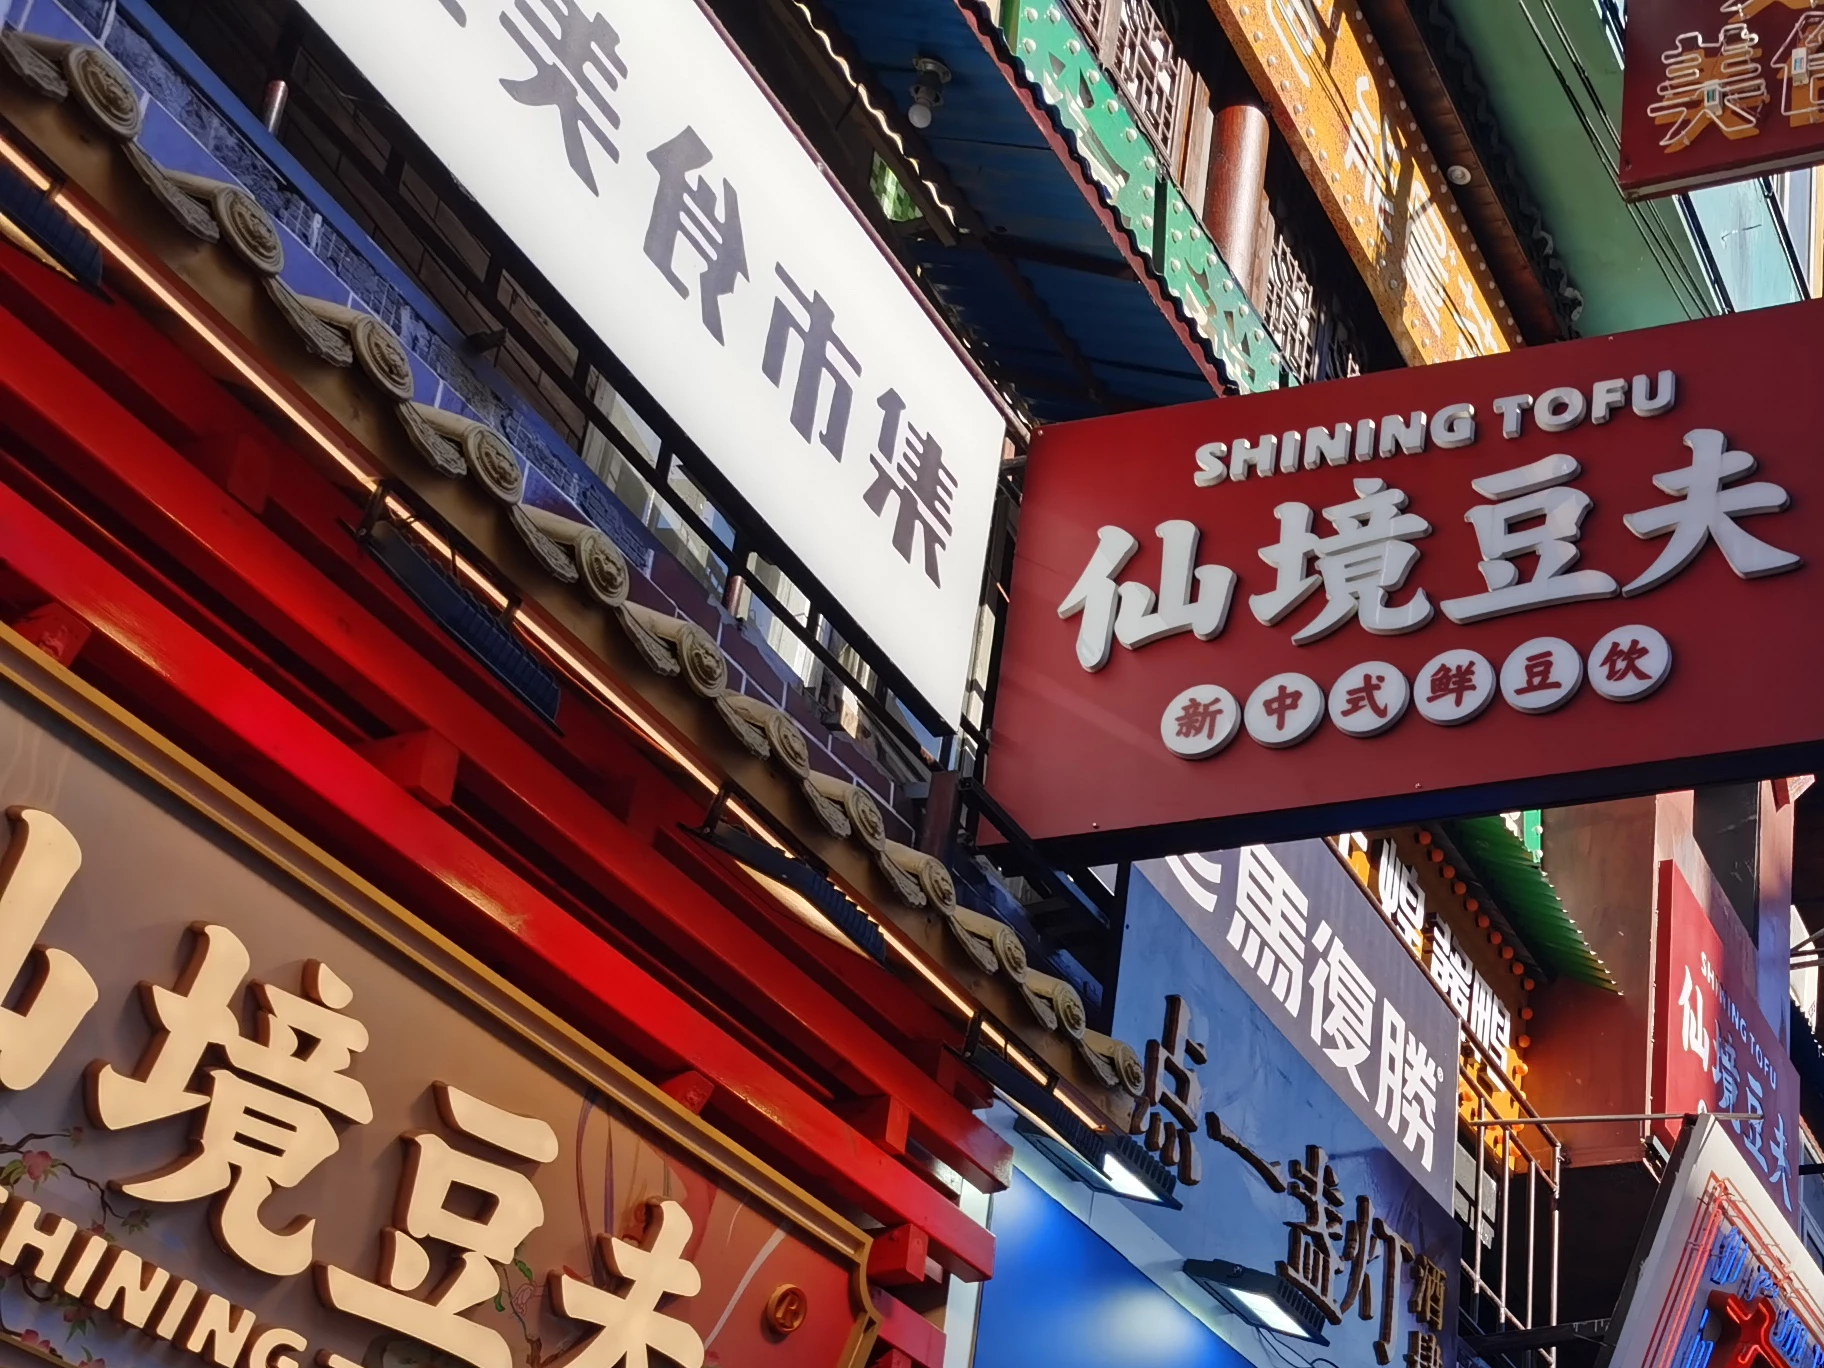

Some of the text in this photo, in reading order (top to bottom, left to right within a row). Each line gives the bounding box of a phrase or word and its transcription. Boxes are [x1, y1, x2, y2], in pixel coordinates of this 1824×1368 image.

[441, 0, 959, 589] 美食市集
[1056, 427, 1802, 673] 仙境豆夫
[1194, 369, 1676, 487] SHINING TOFU
[1163, 626, 1670, 757] 新中式鲜豆饮
[1166, 840, 1437, 1172] 馬復勝
[1678, 964, 1793, 1213] 仙境豆夫
[1700, 951, 1777, 1091] SHINING TOFU
[1130, 993, 1414, 1366] 点一盏灯
